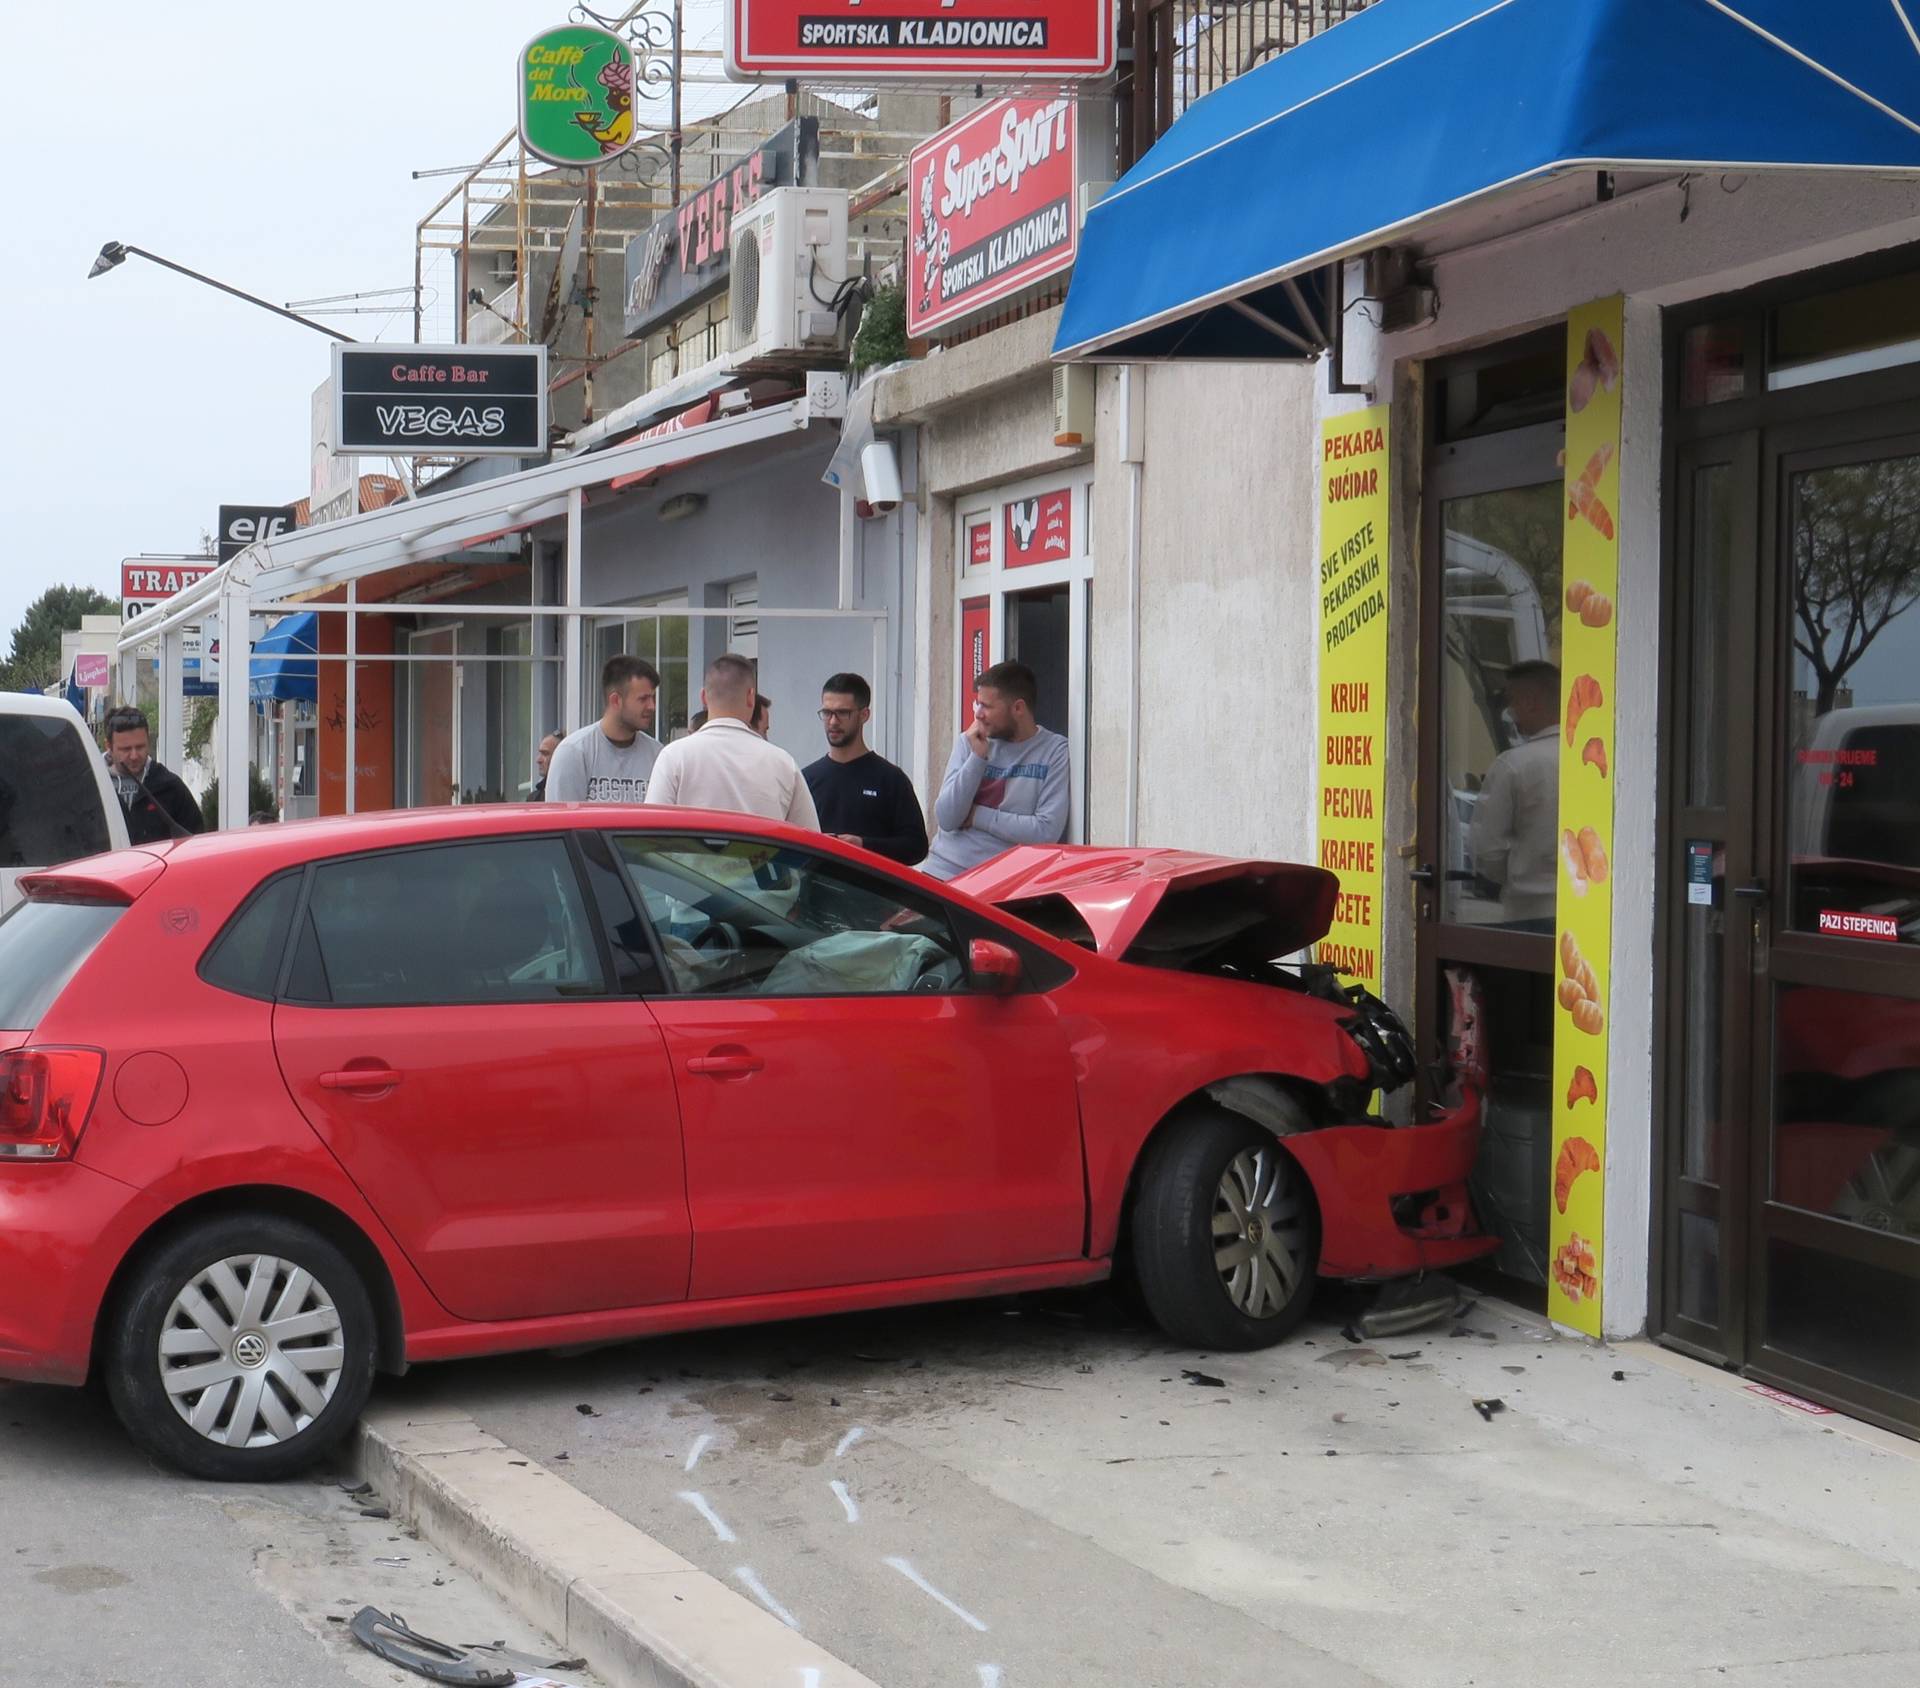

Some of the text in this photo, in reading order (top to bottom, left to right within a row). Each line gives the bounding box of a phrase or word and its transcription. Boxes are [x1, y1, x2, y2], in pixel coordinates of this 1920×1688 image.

[802, 21, 1044, 46] SPORTSKA KLADIONICA
[528, 68, 553, 81] del
[530, 83, 587, 102] Moro
[940, 98, 1070, 217] SuperSport
[941, 202, 1067, 298] SPORTSKA KLADIONICA
[391, 364, 489, 383] Caffe Bar
[376, 405, 505, 437] VEGAS
[1325, 427, 1384, 462] PEKARA
[1328, 466, 1378, 503] SUĆIDAR
[228, 516, 287, 543] elf
[1321, 521, 1374, 584] SVE VRSTE
[1323, 554, 1380, 618] PEKARSKIH
[1326, 589, 1385, 653] PROIZVODA
[1331, 682, 1369, 713] KRUH
[1326, 735, 1373, 766] BUREK
[585, 776, 650, 803] BOSTO
[1840, 771, 1854, 787] 24
[1324, 787, 1373, 819] PECIVA
[1322, 839, 1375, 873] KRAFNE
[1819, 913, 1897, 937] PAZI STEPENICA
[1319, 942, 1374, 979] KROASAN
